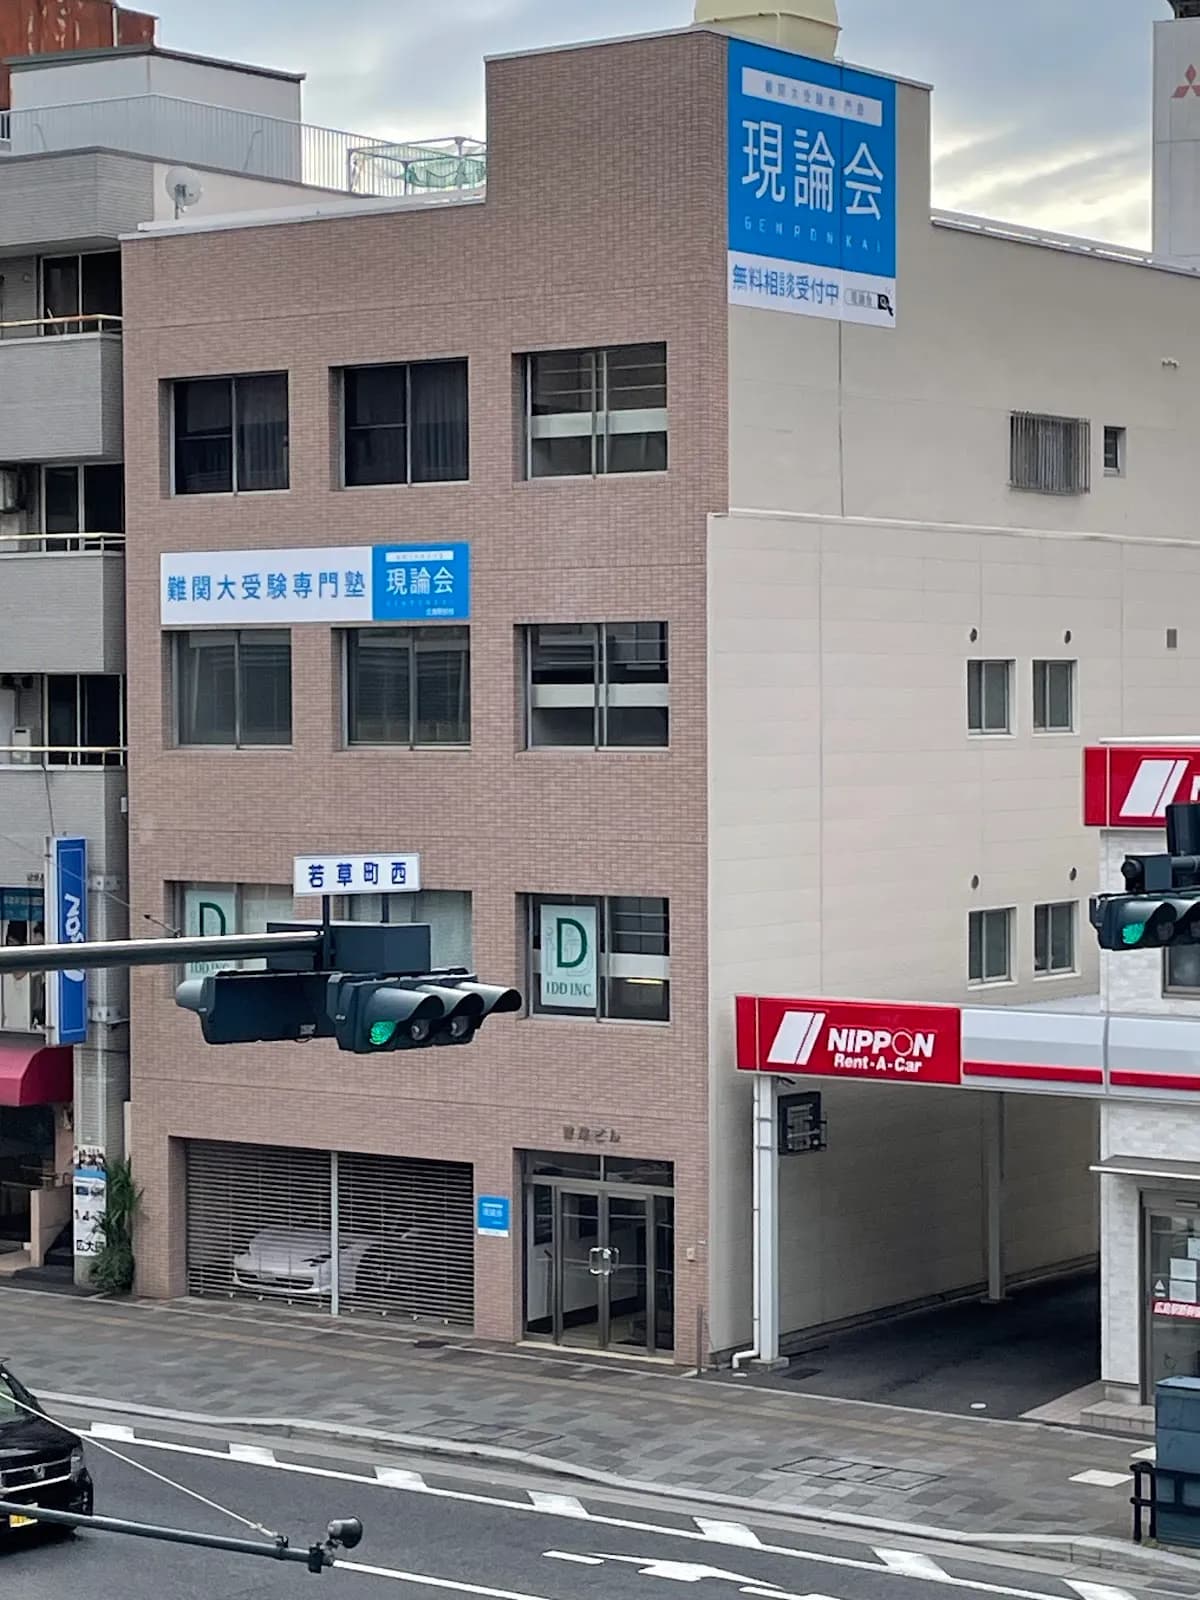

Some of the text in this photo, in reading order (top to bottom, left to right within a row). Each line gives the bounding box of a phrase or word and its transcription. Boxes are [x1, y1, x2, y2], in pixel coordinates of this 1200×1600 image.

[741, 120, 884, 221] 現論会
[732, 263, 839, 305] 無料相談受付中
[167, 570, 366, 602] 難関大受験専門塾
[386, 566, 454, 596] 現論会
[307, 862, 407, 887] 若草町西
[546, 981, 567, 994] IDD
[827, 1027, 935, 1058] NIPPON
[834, 1053, 922, 1073] Rent-A-Car
